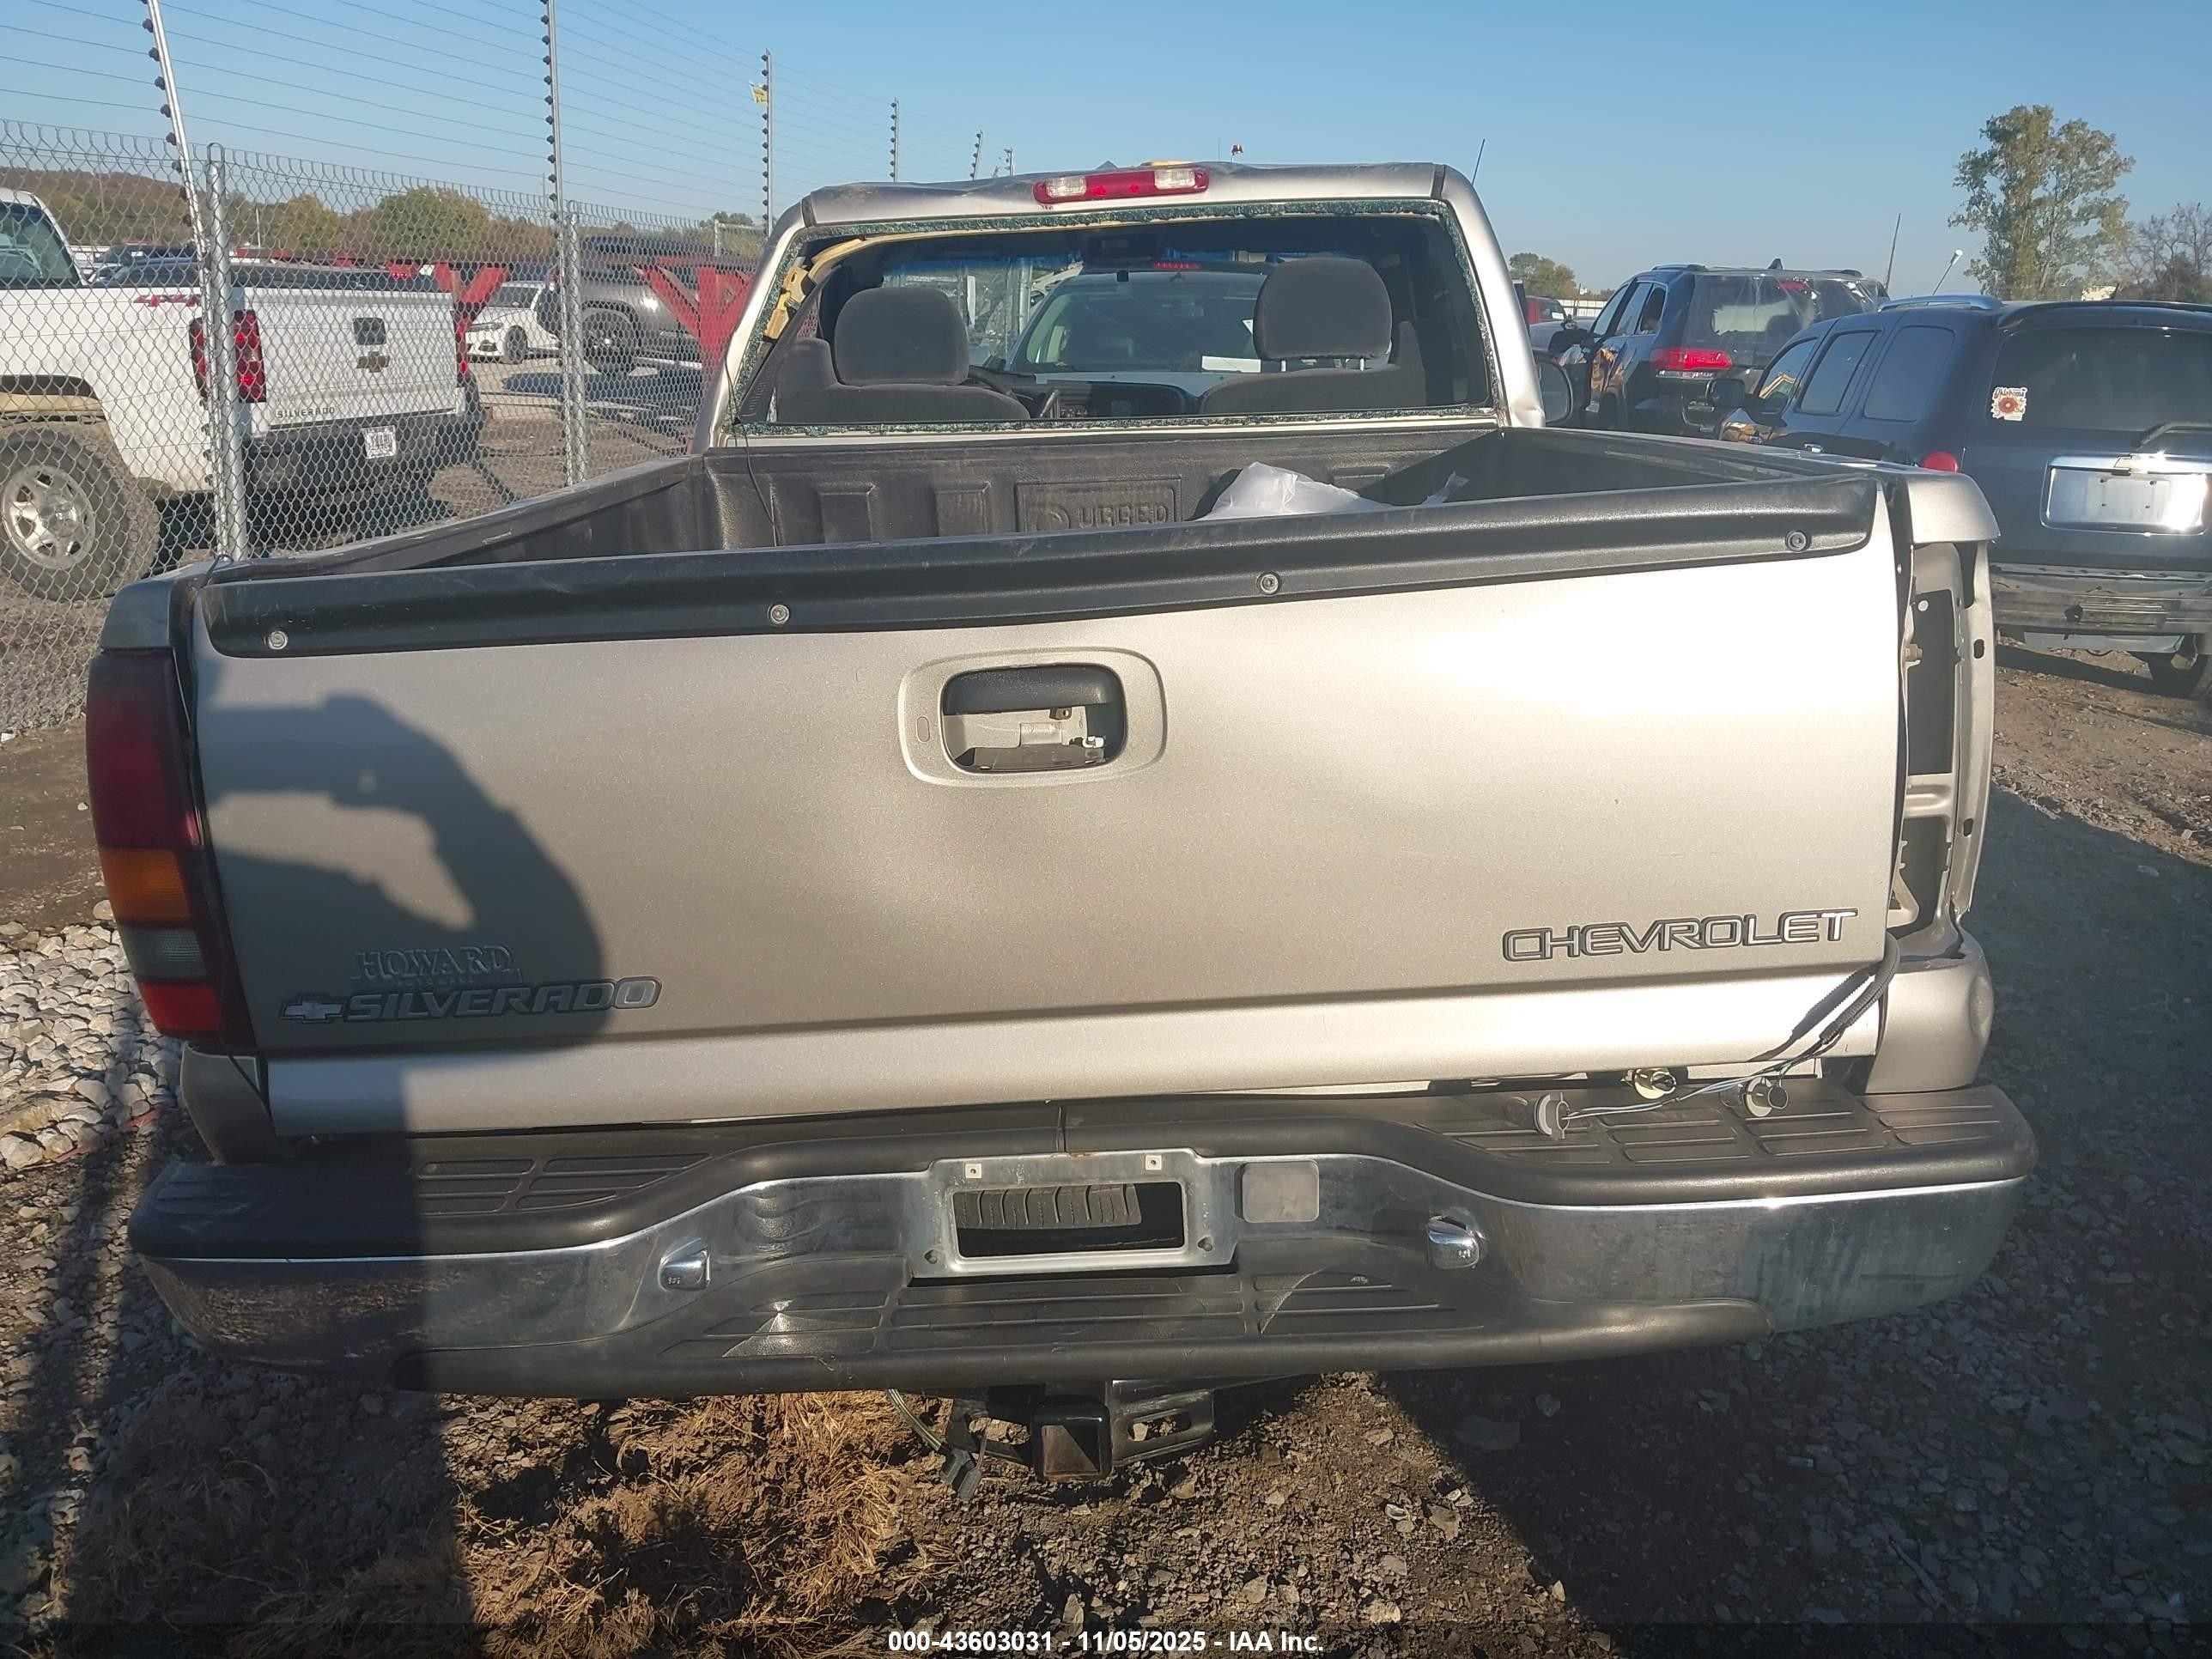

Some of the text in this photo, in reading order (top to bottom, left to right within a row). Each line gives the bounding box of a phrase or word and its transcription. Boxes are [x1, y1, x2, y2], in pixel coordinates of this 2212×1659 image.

[276, 406, 336, 419] SILVERADO
[1503, 908, 1859, 963] CHEVROLET
[350, 945, 517, 980] HOWARD
[343, 976, 662, 1024] SILVERADO
